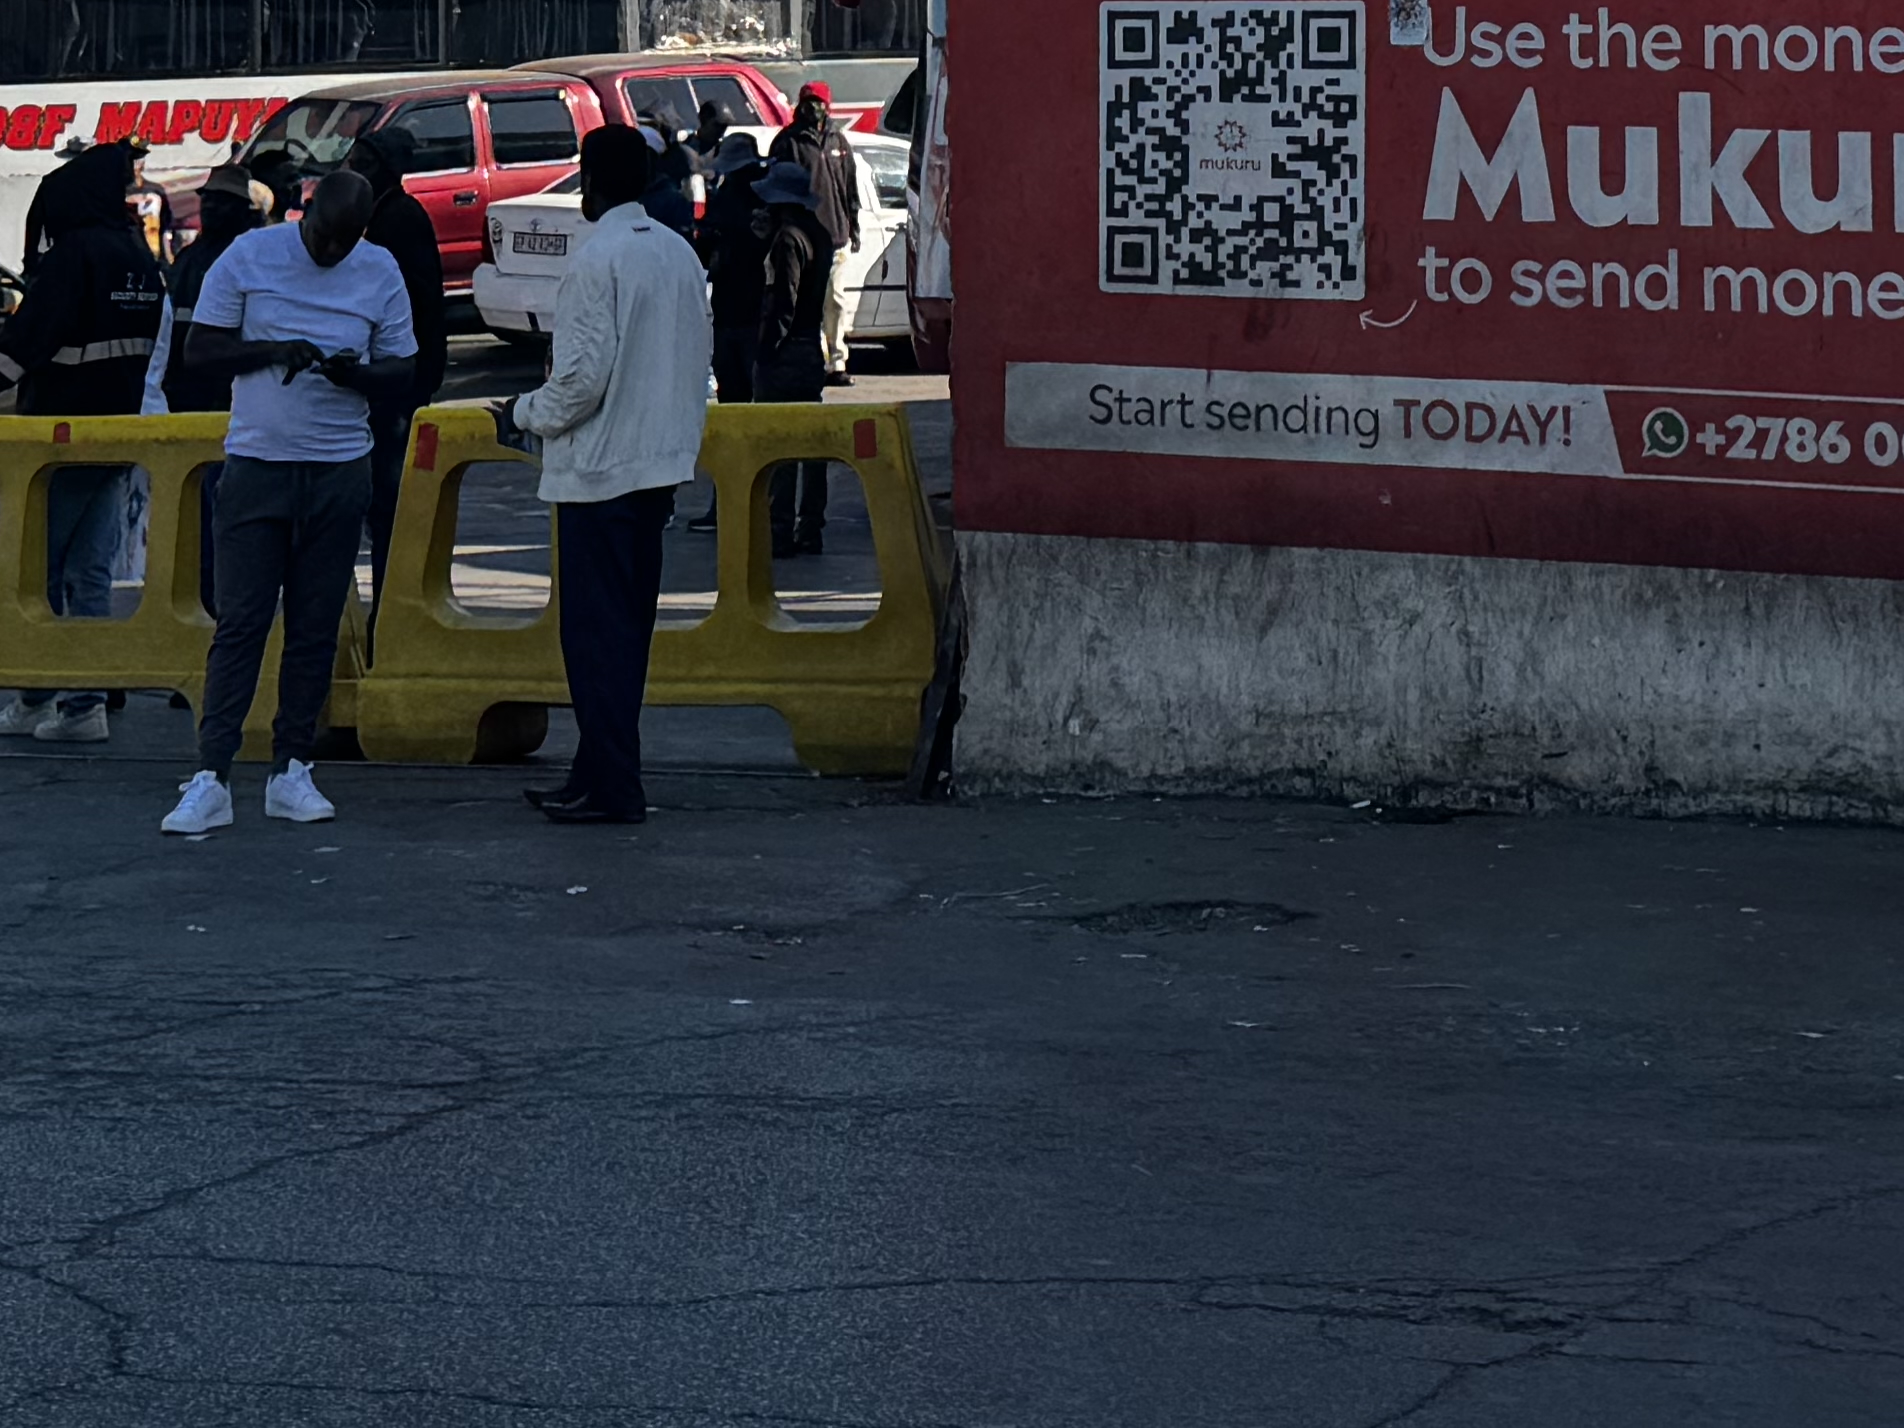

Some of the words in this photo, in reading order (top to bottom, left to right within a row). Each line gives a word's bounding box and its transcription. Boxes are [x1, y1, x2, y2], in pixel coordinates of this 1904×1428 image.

[1424, 5, 1545, 69] Use
[1561, 7, 1683, 72] the
[1200, 157, 1261, 171] mukuru
[1418, 246, 1493, 304] to
[1510, 248, 1679, 312] send
[1088, 384, 1197, 431] Start
[1205, 394, 1380, 448] sending
[1393, 397, 1572, 448] TODAY!
[1696, 414, 1851, 466] +2786
